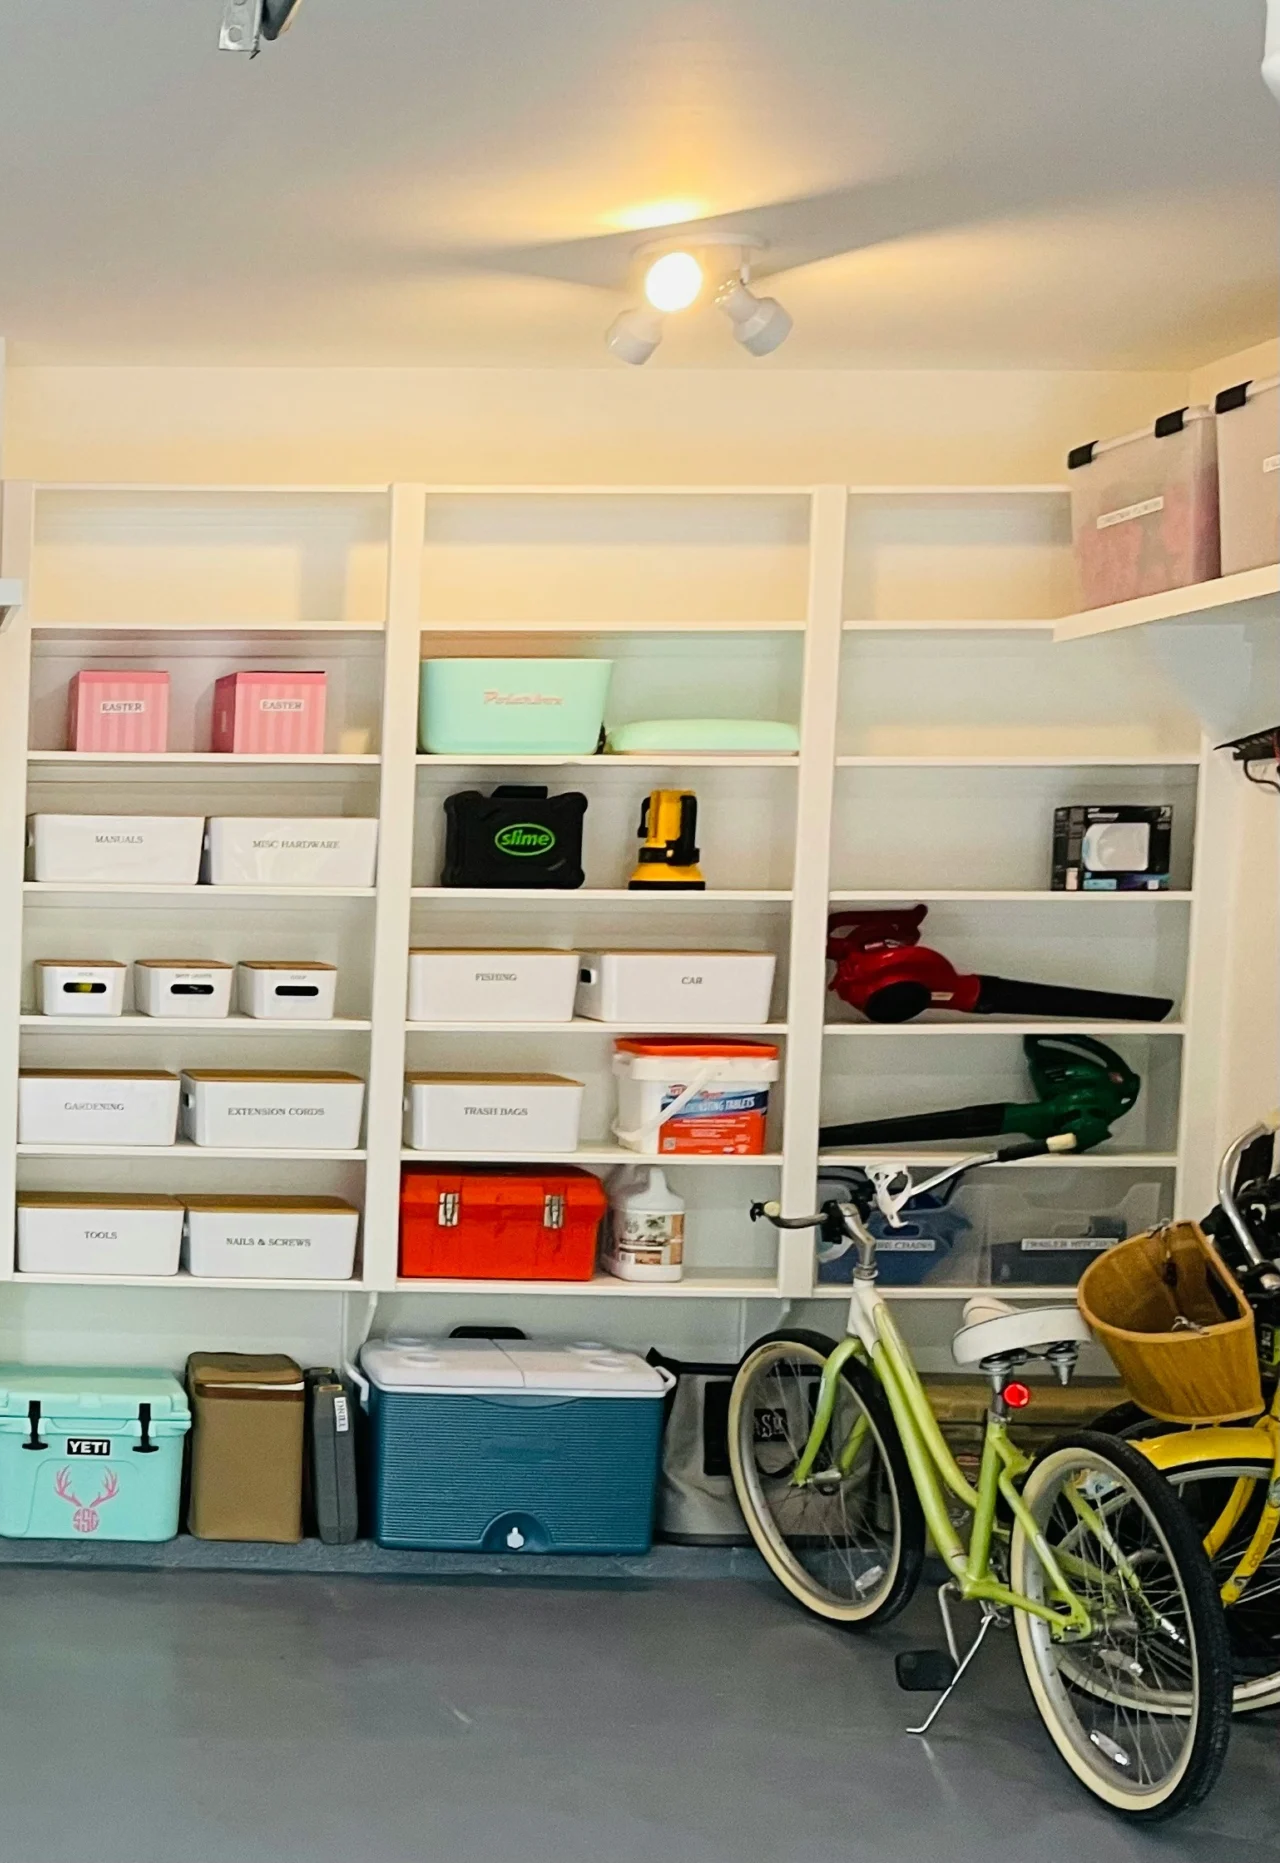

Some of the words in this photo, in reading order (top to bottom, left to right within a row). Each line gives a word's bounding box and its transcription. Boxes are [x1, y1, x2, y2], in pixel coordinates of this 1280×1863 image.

[102, 703, 141, 711] EASTER
[262, 701, 302, 709] EASTER
[95, 835, 144, 844] MANUALS
[501, 829, 550, 846] slime
[252, 840, 277, 849] MISC
[281, 840, 340, 849] HARDWARE
[475, 973, 517, 981] FISHING
[681, 976, 703, 985] CAR
[64, 1102, 125, 1111] GARDENING
[463, 1106, 498, 1116] TRASH
[500, 1107, 528, 1116] BAGS
[227, 1107, 286, 1116] EXTENSION
[288, 1107, 325, 1116] CORDS
[83, 1231, 118, 1240] TOOLS
[226, 1237, 255, 1246] NAILS
[257, 1238, 266, 1246] &
[268, 1238, 311, 1247] SCREWS
[336, 1400, 346, 1427] DRILL
[69, 1440, 108, 1454] YETI
